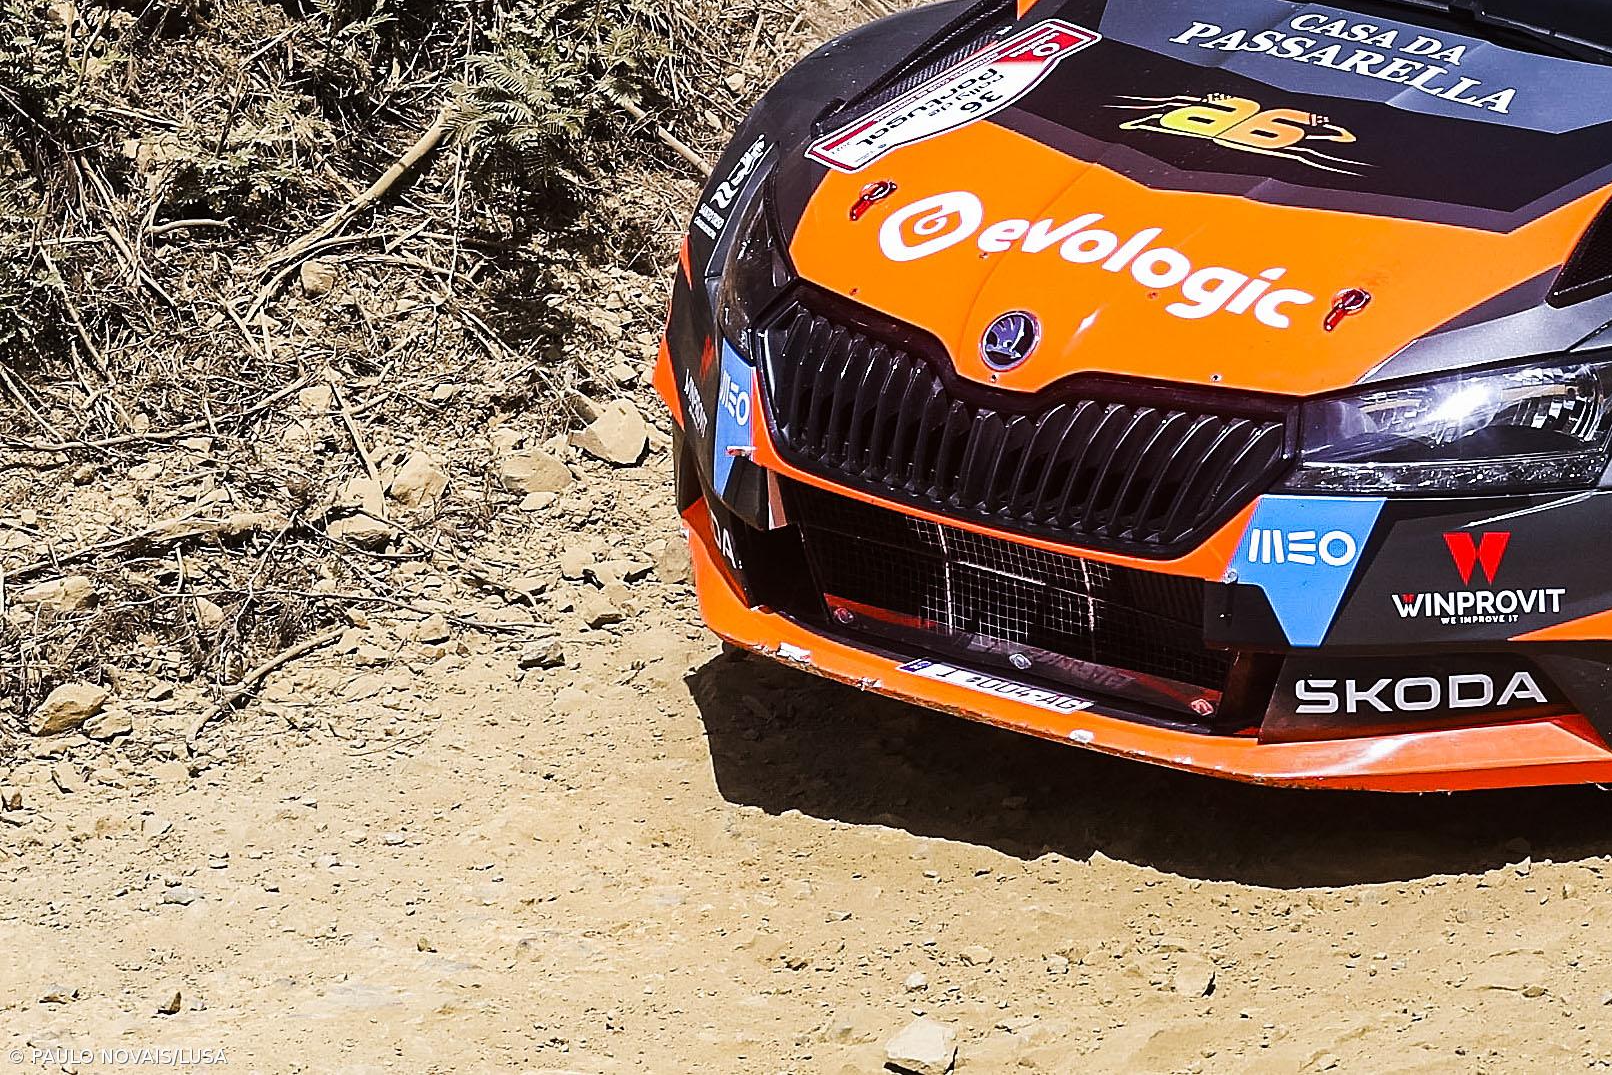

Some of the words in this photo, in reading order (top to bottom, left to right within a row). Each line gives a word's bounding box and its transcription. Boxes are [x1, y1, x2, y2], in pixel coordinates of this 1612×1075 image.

[1288, 13, 1403, 48] CASA
[1401, 34, 1468, 65] DA
[1169, 20, 1519, 114] PASSARELLA
[960, 90, 1004, 113] 36
[976, 212, 1315, 329] evologic
[1248, 529, 1357, 566] MEO
[1391, 588, 1566, 618] WINPROVIT
[1460, 615, 1506, 624] IMPROVE
